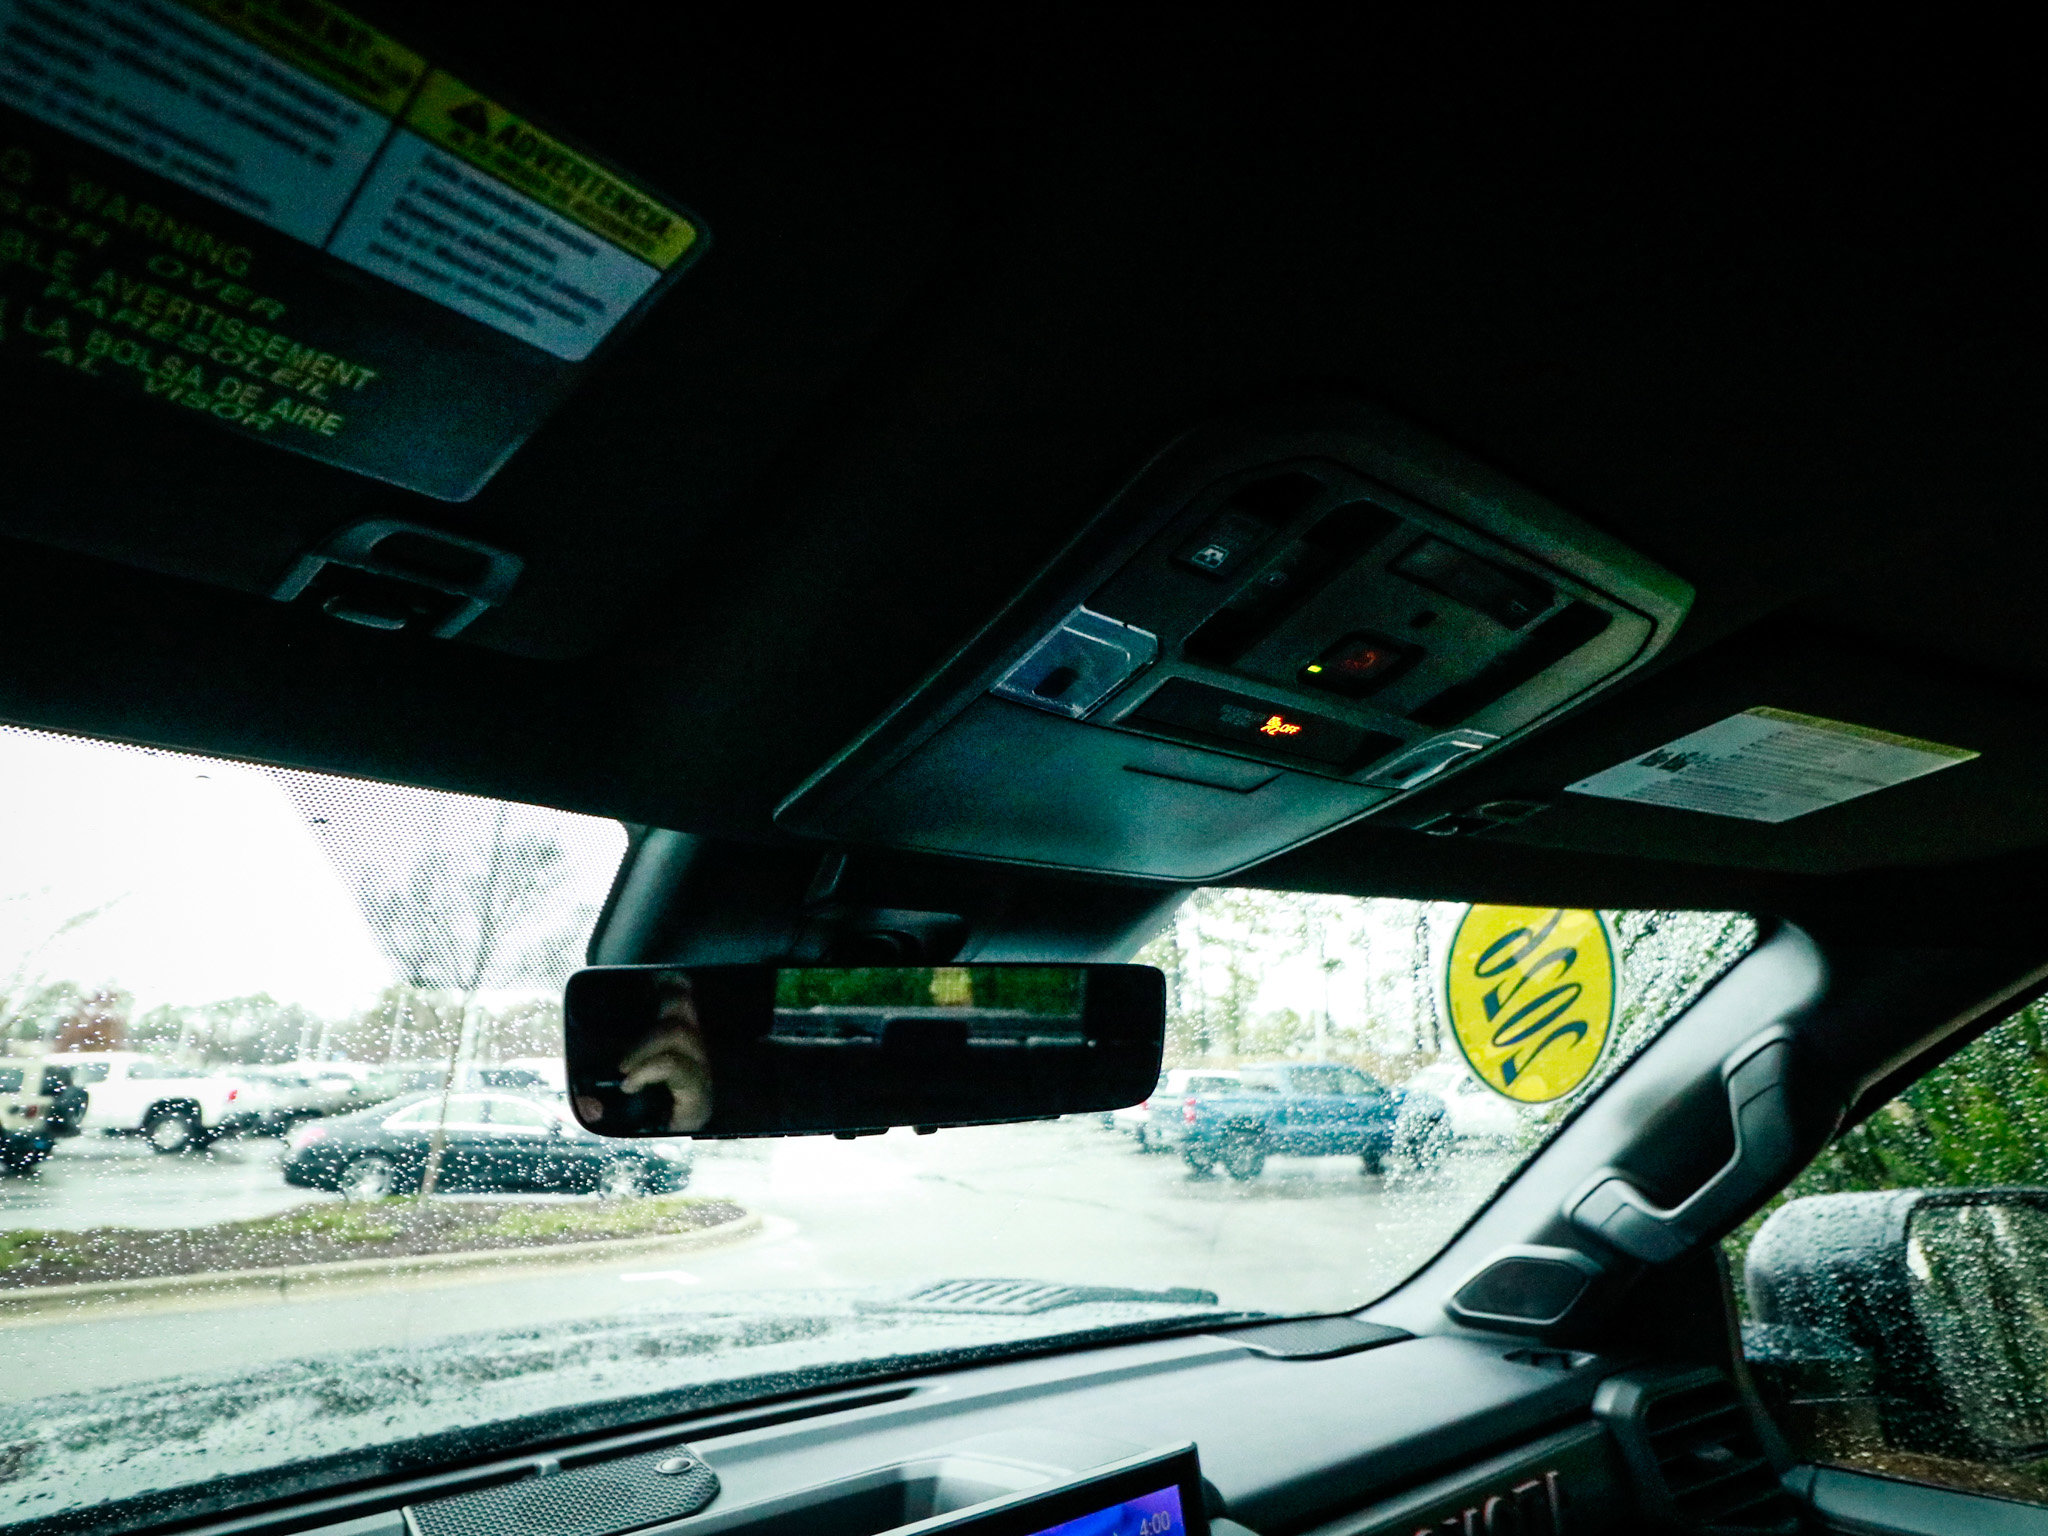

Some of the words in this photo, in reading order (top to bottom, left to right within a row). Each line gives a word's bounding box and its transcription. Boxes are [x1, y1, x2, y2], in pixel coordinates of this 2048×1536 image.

[67, 174, 251, 276] WARNING
[91, 268, 378, 391] AVERTISSEMENT
[147, 252, 286, 321] OVER
[22, 305, 71, 343] LA
[85, 327, 204, 388] BOLSA
[216, 375, 265, 410] DE
[270, 396, 345, 437] AIRE
[39, 345, 101, 378] AL
[142, 375, 275, 432] VISOR
[1277, 722, 1301, 734] OFF
[1140, 1510, 1170, 1536] 4:00
